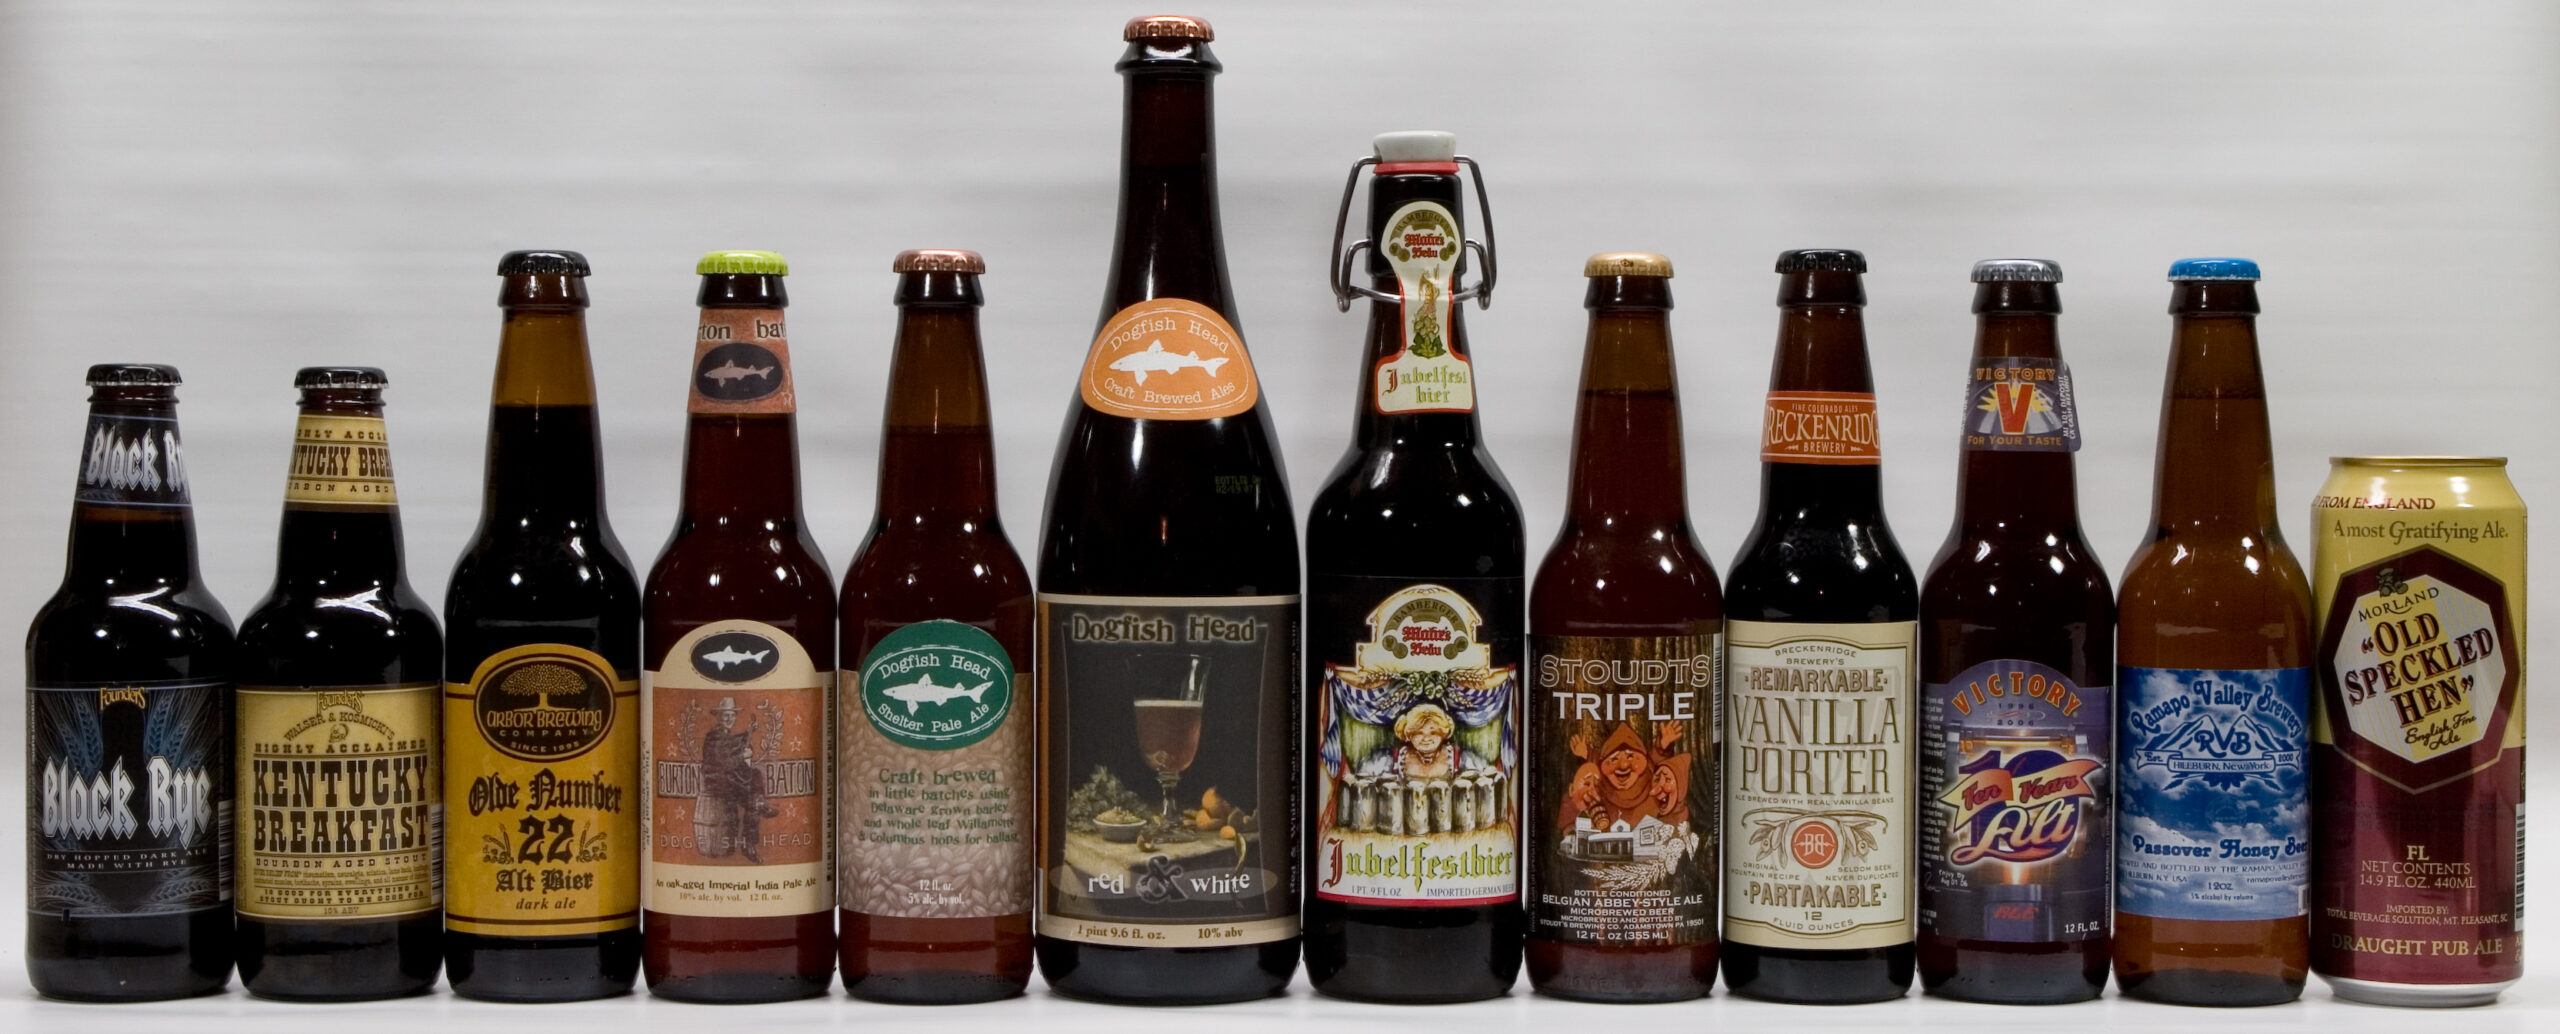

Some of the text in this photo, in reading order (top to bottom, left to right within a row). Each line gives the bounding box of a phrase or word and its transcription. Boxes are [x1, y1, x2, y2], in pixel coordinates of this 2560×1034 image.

[1110, 317, 1229, 354] Dogfish Head
[1976, 367, 2056, 381] VICTORY
[1104, 377, 1236, 404] Craft Brewed Ales
[1416, 386, 1450, 404] bier
[1808, 404, 1842, 413] COLORADO
[1994, 382, 2035, 435] V
[1803, 441, 1846, 453] BREWERY
[86, 423, 161, 492] Black
[2347, 520, 2509, 545] most Gratifying Ale.
[1393, 600, 1460, 624] BAMBERGER
[2358, 586, 2440, 623] MORLAND
[1073, 612, 1255, 643] Dogfish Head
[1775, 645, 1857, 658] BRECKENRIDGE
[878, 653, 991, 680] Dogfish Head
[1786, 657, 1845, 666] BREWERY'S
[2344, 627, 2494, 706] SPECKLED
[1540, 654, 1710, 687] STOUDTS
[1750, 667, 1884, 693] REMARKABLE
[100, 685, 146, 710] Founders
[1952, 672, 2082, 717] VICTORY
[1552, 691, 1694, 721] TRIPLE
[2131, 680, 2302, 738] Ramapo Valley Brewery
[283, 711, 396, 742] WALSER KOSMICKI'S
[878, 703, 990, 733] Shelter Pale Ale
[1732, 694, 1900, 746] VANILLA
[2404, 717, 2451, 747] English
[255, 739, 426, 753] HIGHLY ACCLAIMED
[510, 741, 580, 752] SINCE 1995
[2429, 731, 2462, 751] Ale
[658, 762, 815, 795] BURTON BATON
[879, 768, 996, 785] Craft brewed
[1740, 745, 1890, 796] PORTER
[253, 755, 427, 808] KENTUCKY
[468, 768, 622, 817] Olde Number
[885, 786, 1010, 800] little batches using
[1748, 795, 1779, 804] BREWED
[1808, 798, 1829, 806] REAL
[1833, 798, 1869, 806] VANILLA
[1962, 774, 2079, 811] Ten Years
[42, 755, 138, 840] Black
[147, 755, 212, 850] Rye
[871, 802, 971, 816] Delaware grown
[254, 804, 427, 853] BREAKFAST
[1950, 797, 2076, 867] Alt
[518, 814, 575, 865] 22
[660, 833, 812, 849] DOGFISH HEAD
[870, 831, 925, 845] Columbus
[2132, 835, 2280, 860] Passover Honey
[2406, 845, 2430, 861] FL
[67, 859, 187, 870] MADE WITH RYE
[74, 851, 177, 863] HOPPED DARK
[256, 853, 427, 868] BOURBON AGED STOUT
[1322, 837, 1514, 893] Jubelfestbier
[1743, 862, 1779, 872] ORIGINAL
[1838, 865, 1871, 873] SELDOM
[2160, 863, 2275, 874] BOTTLED BY THE RAMAPO
[2361, 860, 2471, 875] NET CONTENTS
[496, 868, 594, 894] Alt Bier
[709, 879, 802, 891] Imperial India Pale
[1088, 872, 1250, 894] red white
[1768, 872, 1800, 881] RECIPE
[2359, 873, 2476, 889] 14.9 FL.OZ. 440ML
[1426, 885, 1501, 897] IMPORTED GERMAN
[1574, 889, 1671, 898] BOTTLE CONDITIONED
[1749, 881, 1882, 908] PARTAKABLE
[516, 898, 576, 910] dark ale
[1542, 894, 1703, 908] BELGIAN ABBEY-STYLE ALE
[2386, 903, 2434, 915] IMPORTED
[1561, 915, 1619, 924] MICROBREWED
[1639, 915, 1673, 923] BOTTLED
[1570, 907, 1675, 916] MICROBREWED BEER
[1804, 911, 1823, 921] 12
[2327, 907, 2500, 926] TOTAL BEVERAGE SOLUTION, PLEASANT,
[1086, 926, 1165, 939] pint 9.6 fl. oz.
[1569, 921, 1674, 931] BREWING ADAMSTOWN
[1773, 917, 1855, 931] FLUID OUNCES
[2065, 922, 2076, 934] 12
[1198, 928, 1243, 939] 10% abv
[1576, 930, 1669, 940] 12 OZ (355 ML)
[2331, 932, 2426, 955] DRAUGHT
[2431, 939, 2469, 955] PUB
[2473, 937, 2503, 955] ALE
